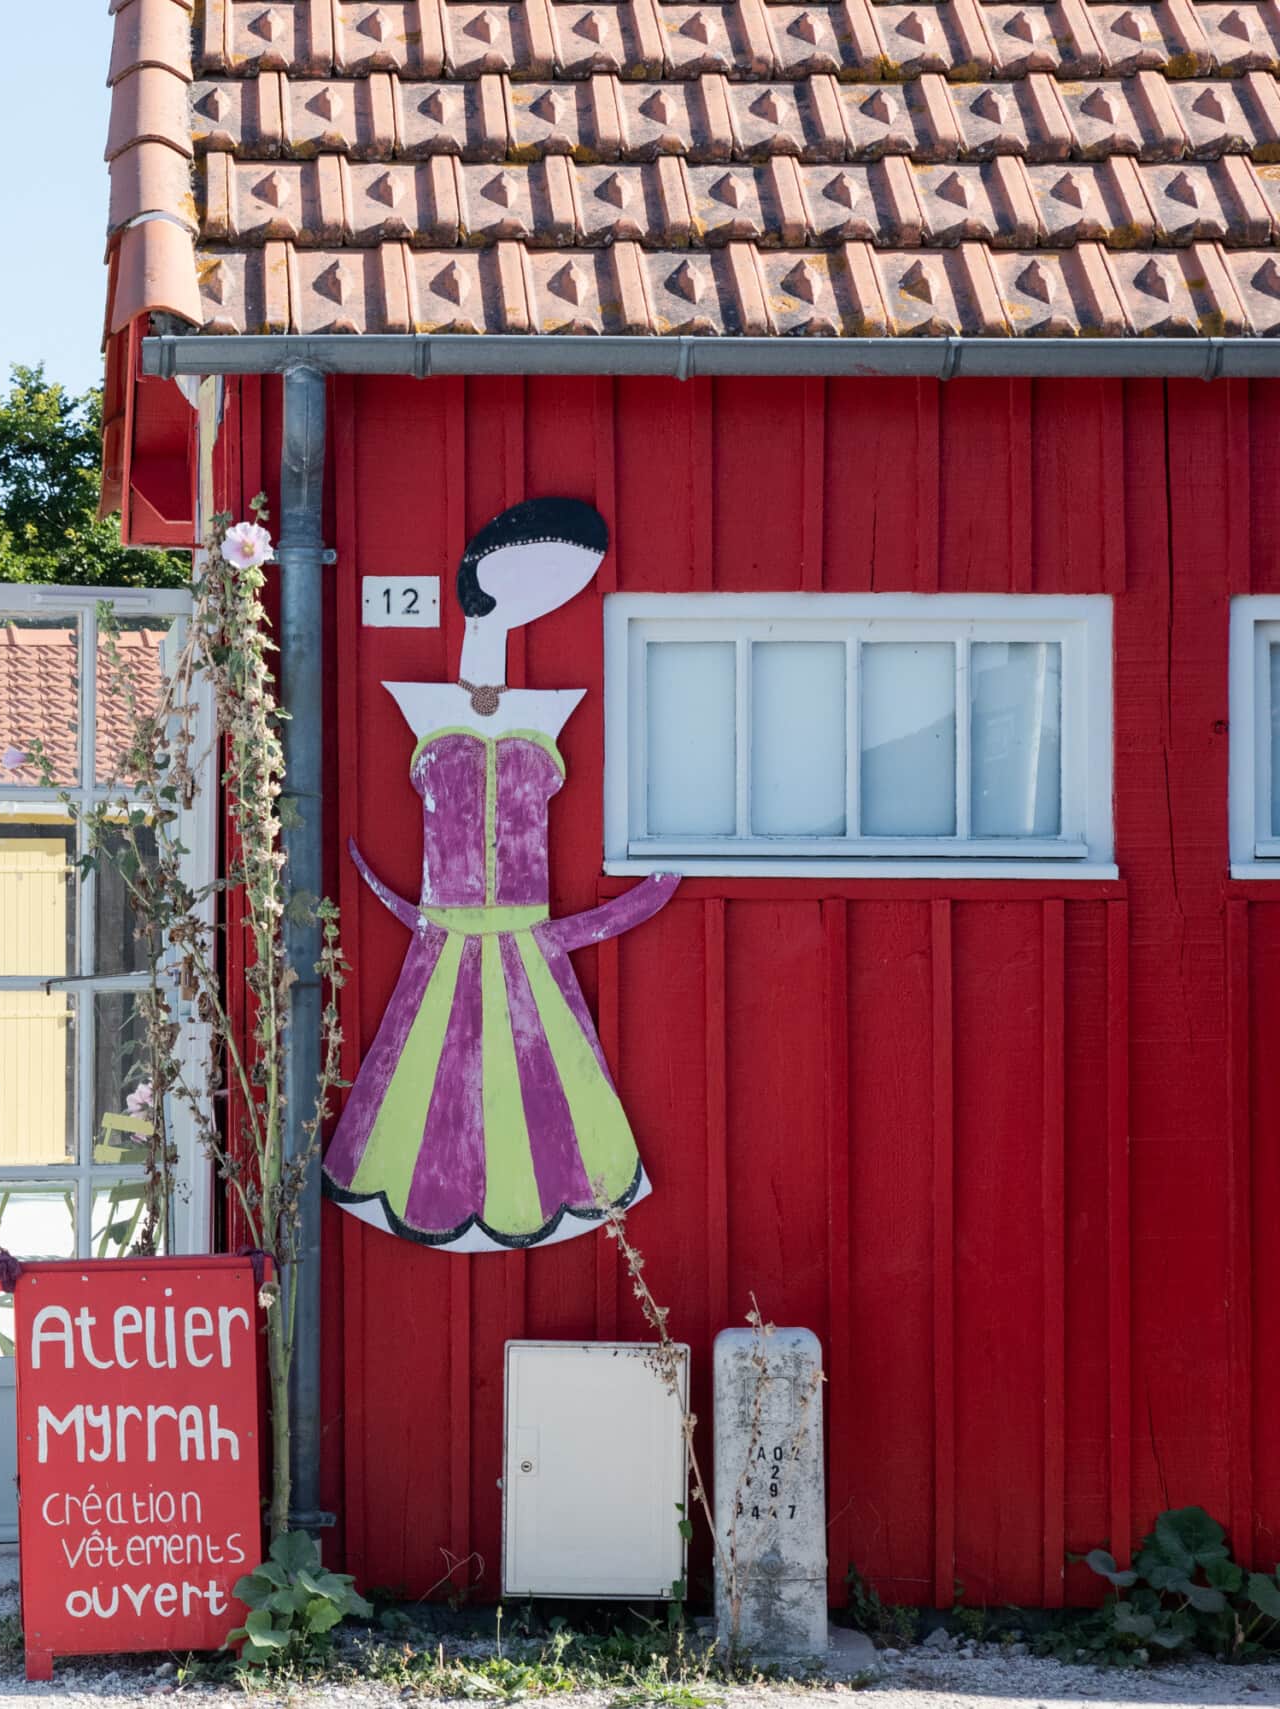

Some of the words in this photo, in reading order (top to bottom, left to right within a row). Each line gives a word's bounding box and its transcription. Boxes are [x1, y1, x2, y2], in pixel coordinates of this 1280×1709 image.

[383, 588, 420, 615] 12
[31, 1288, 250, 1369] Atelier
[65, 1580, 228, 1618] ouvert
